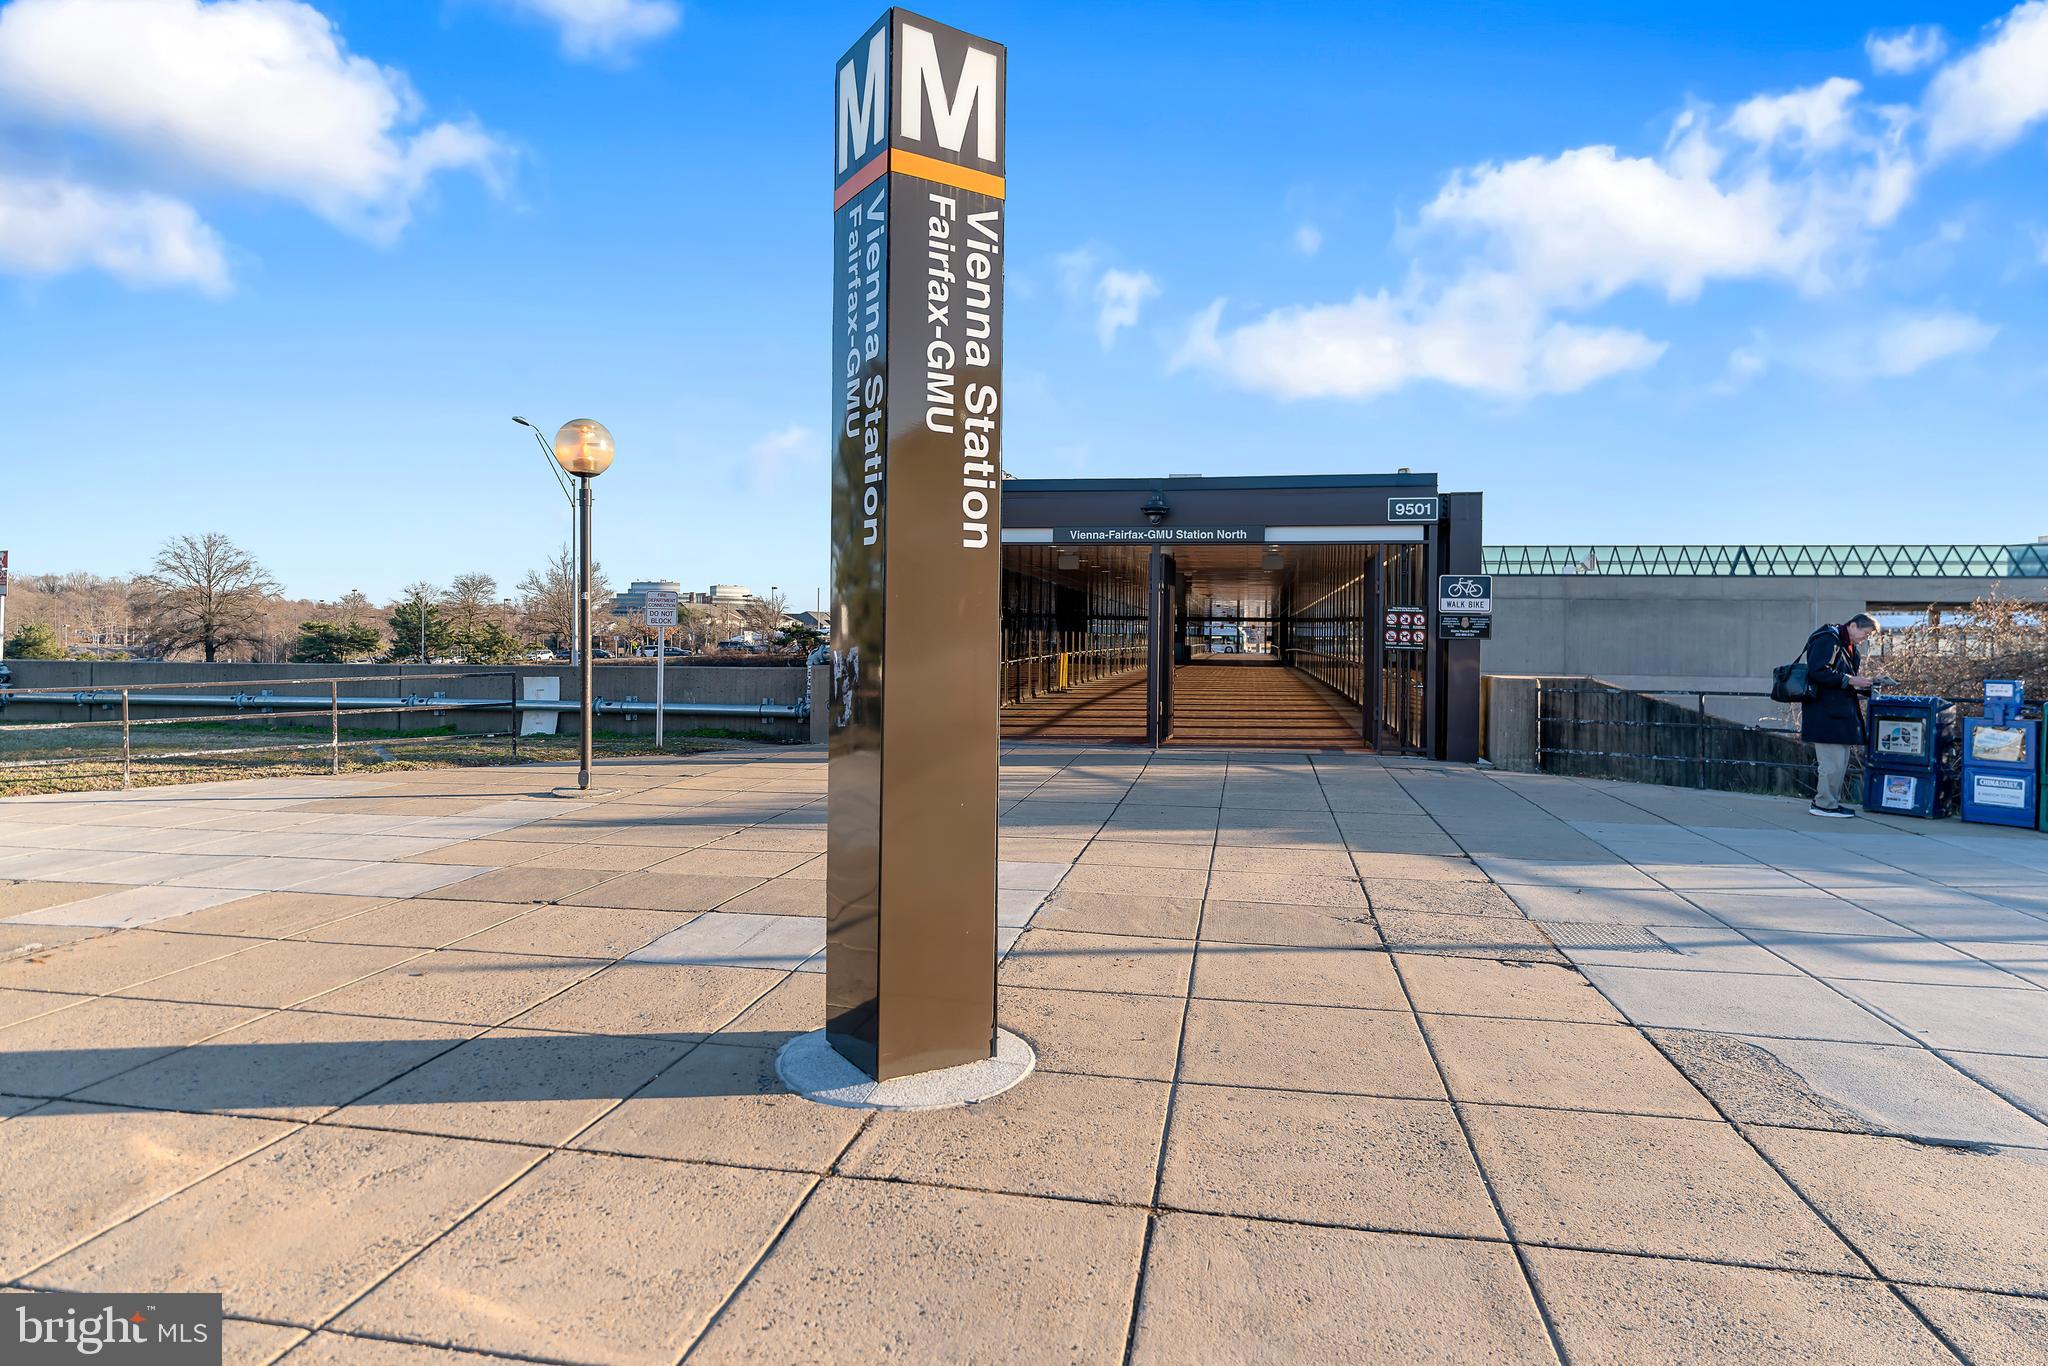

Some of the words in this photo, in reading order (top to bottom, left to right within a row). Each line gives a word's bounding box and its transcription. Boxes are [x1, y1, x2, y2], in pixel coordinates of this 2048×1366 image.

[838, 25, 886, 175] M
[900, 23, 997, 163] M
[846, 203, 863, 439] Fairfax-GMU
[864, 188, 885, 362] Vienna
[925, 193, 956, 435] Fairfax-GMU
[965, 210, 999, 368] Vienna
[863, 374, 884, 547] Station
[962, 383, 998, 549] Station
[1070, 529, 1173, 540] Vienna-Fairfax-GMU
[1176, 529, 1214, 540] Station
[1216, 529, 1247, 539] North
[1395, 503, 1431, 516] 9501
[1447, 600, 1465, 609] WALK
[1468, 600, 1484, 609] BIKE
